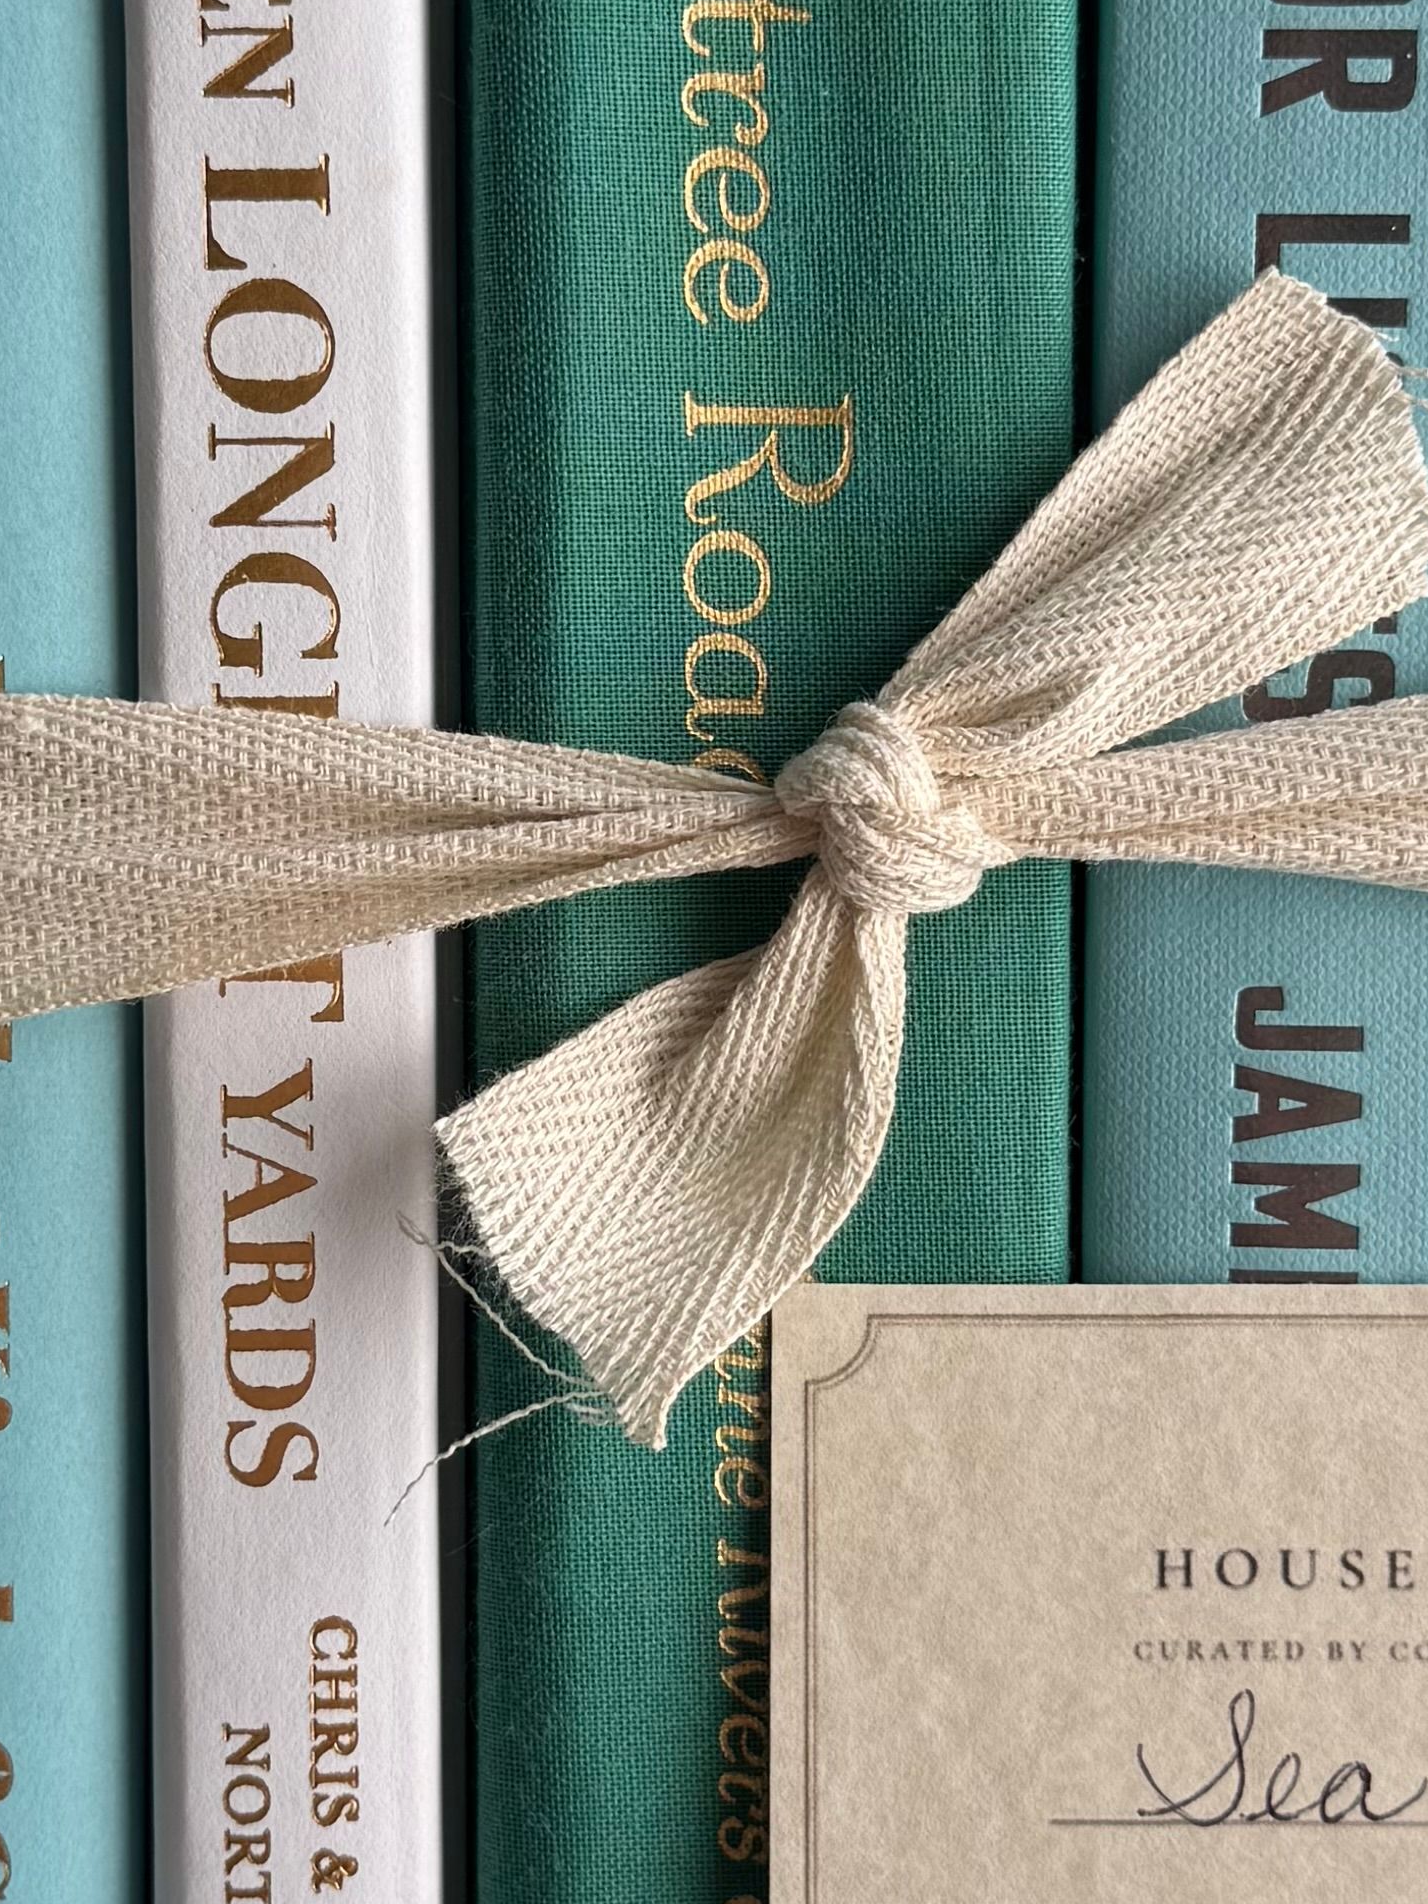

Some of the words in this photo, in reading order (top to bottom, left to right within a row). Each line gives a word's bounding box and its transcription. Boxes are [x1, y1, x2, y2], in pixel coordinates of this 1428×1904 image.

[682, 392, 856, 782] Roa
[1228, 985, 1365, 1284] JAM
[220, 1057, 319, 1488] YARDS
[1133, 1639, 1305, 1663] CURATED
[1327, 1641, 1366, 1662] BY
[1156, 1548, 1415, 1591] HOUSE
[309, 1614, 359, 1827] CHRIS
[1137, 1688, 1428, 1827] Sea
[310, 1847, 359, 1894] &
